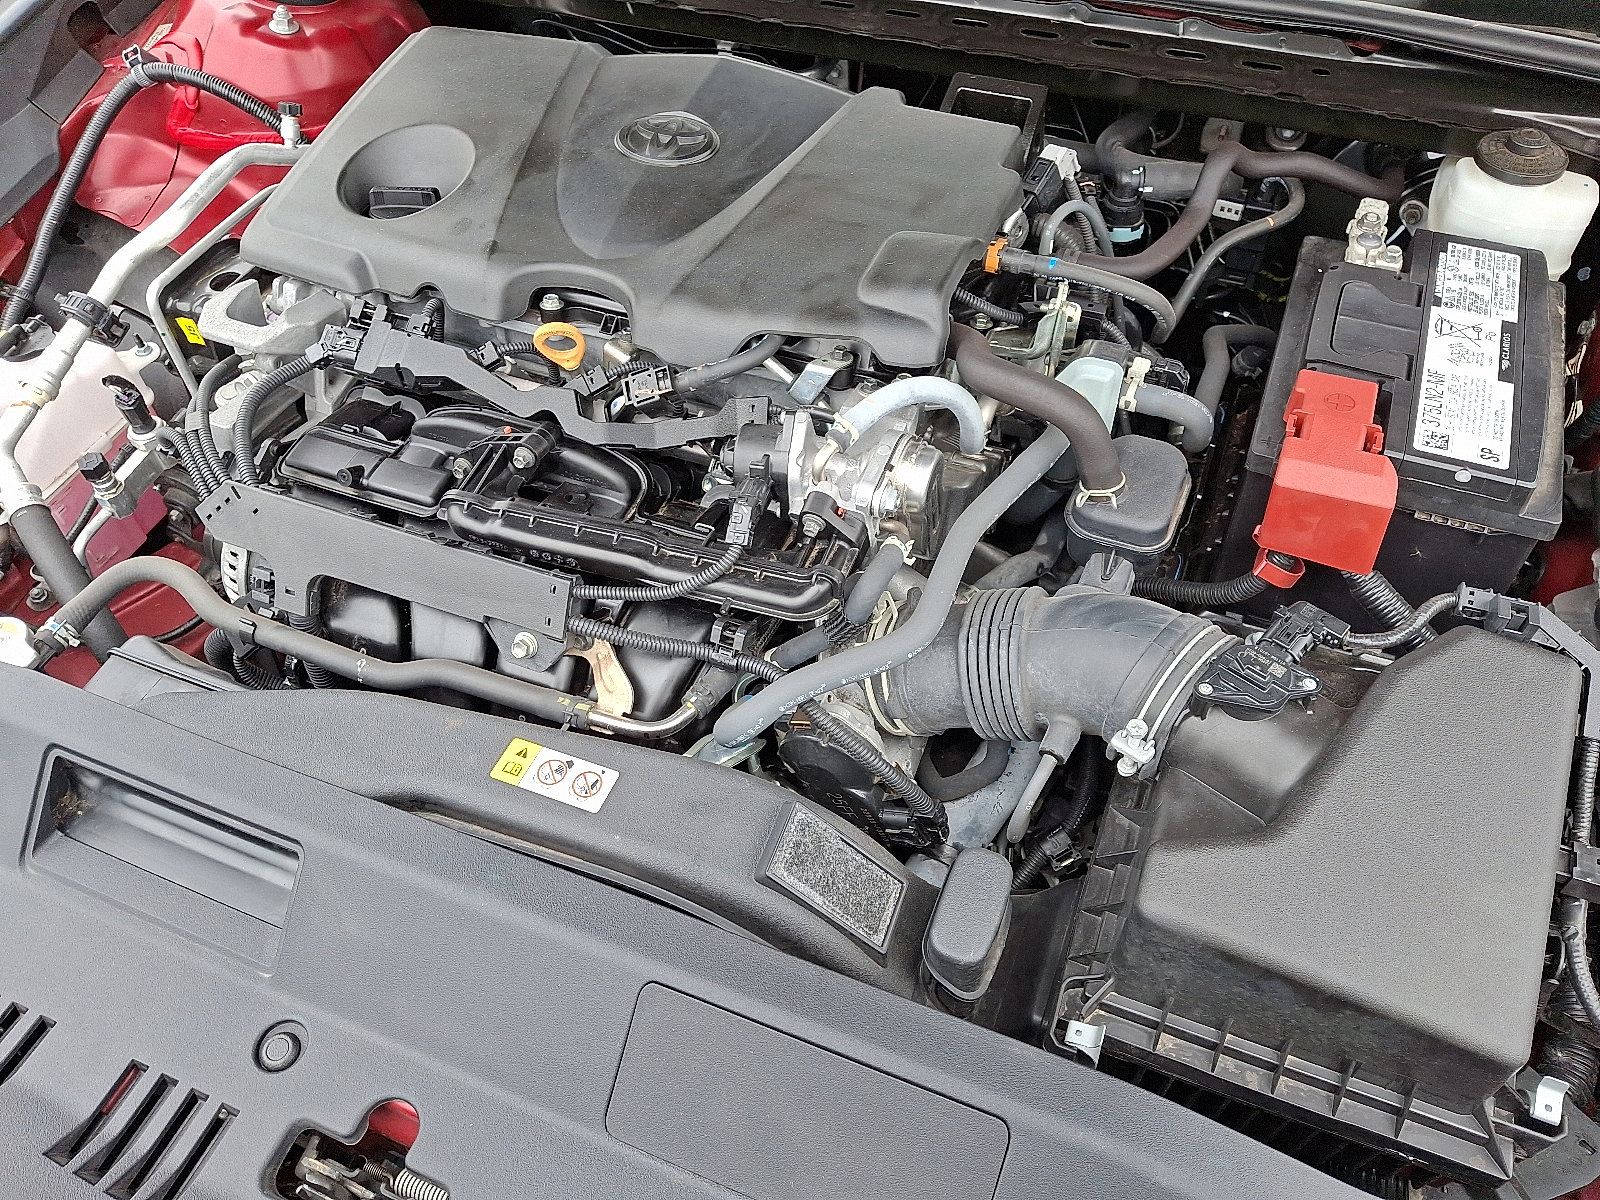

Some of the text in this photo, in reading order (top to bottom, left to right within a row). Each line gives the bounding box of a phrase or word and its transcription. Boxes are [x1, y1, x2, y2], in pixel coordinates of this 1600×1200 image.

[1501, 333, 1511, 360] CLARIOS
[1421, 368, 1446, 428] 375LN2-MF
[1480, 447, 1500, 462] SP
